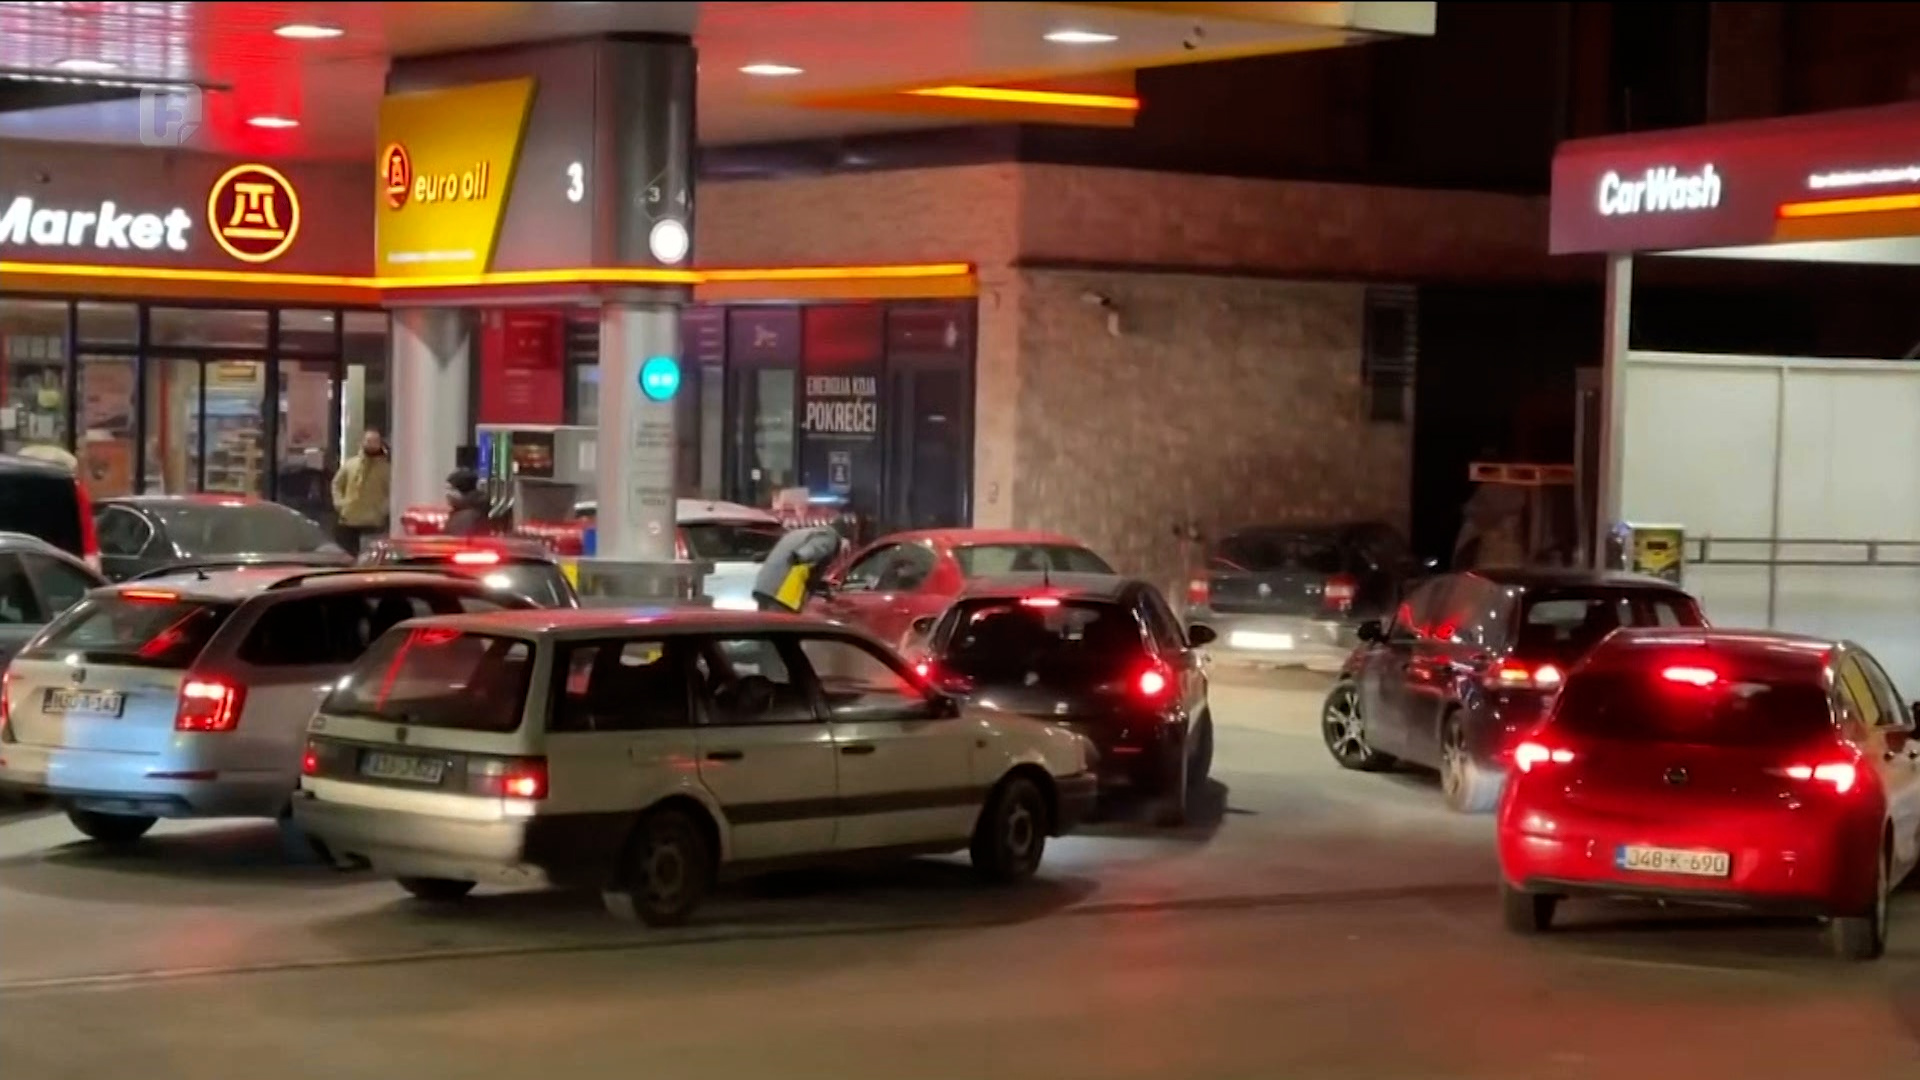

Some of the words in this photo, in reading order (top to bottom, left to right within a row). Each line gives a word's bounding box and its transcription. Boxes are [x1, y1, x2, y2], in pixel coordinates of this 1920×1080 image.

[414, 172, 459, 201] euro
[461, 161, 490, 200] oil
[566, 161, 585, 203] 3
[648, 186, 661, 202] 3
[1599, 163, 1721, 216] CarWash
